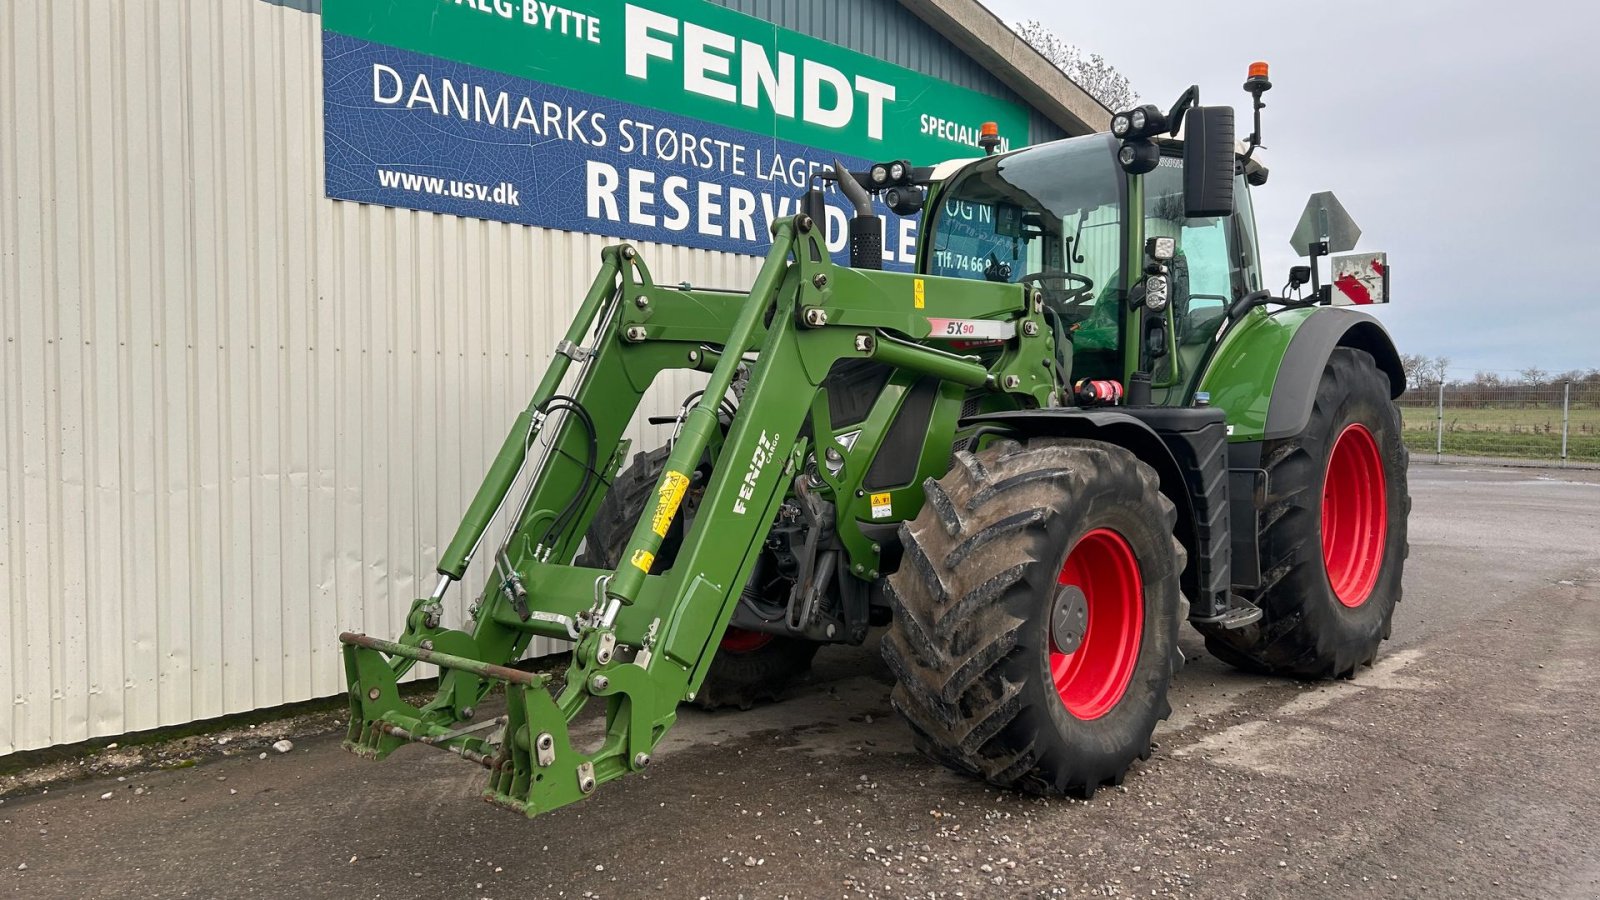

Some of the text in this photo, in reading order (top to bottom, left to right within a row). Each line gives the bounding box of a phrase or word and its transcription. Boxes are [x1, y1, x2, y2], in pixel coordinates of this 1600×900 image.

[625, 3, 896, 140] FENDT
[373, 63, 607, 147] DANMARKS
[618, 118, 746, 176] STØRSTE
[946, 200, 972, 220] OG
[920, 113, 1009, 153] SPECIALIN
[377, 169, 520, 206] www.usv.dk
[586, 159, 917, 265] RESERVDLE
[937, 251, 954, 269] Tlf.
[957, 254, 969, 271] 74
[971, 257, 982, 273] 66
[732, 428, 771, 515] FENDT
[766, 433, 780, 464] CARGO
